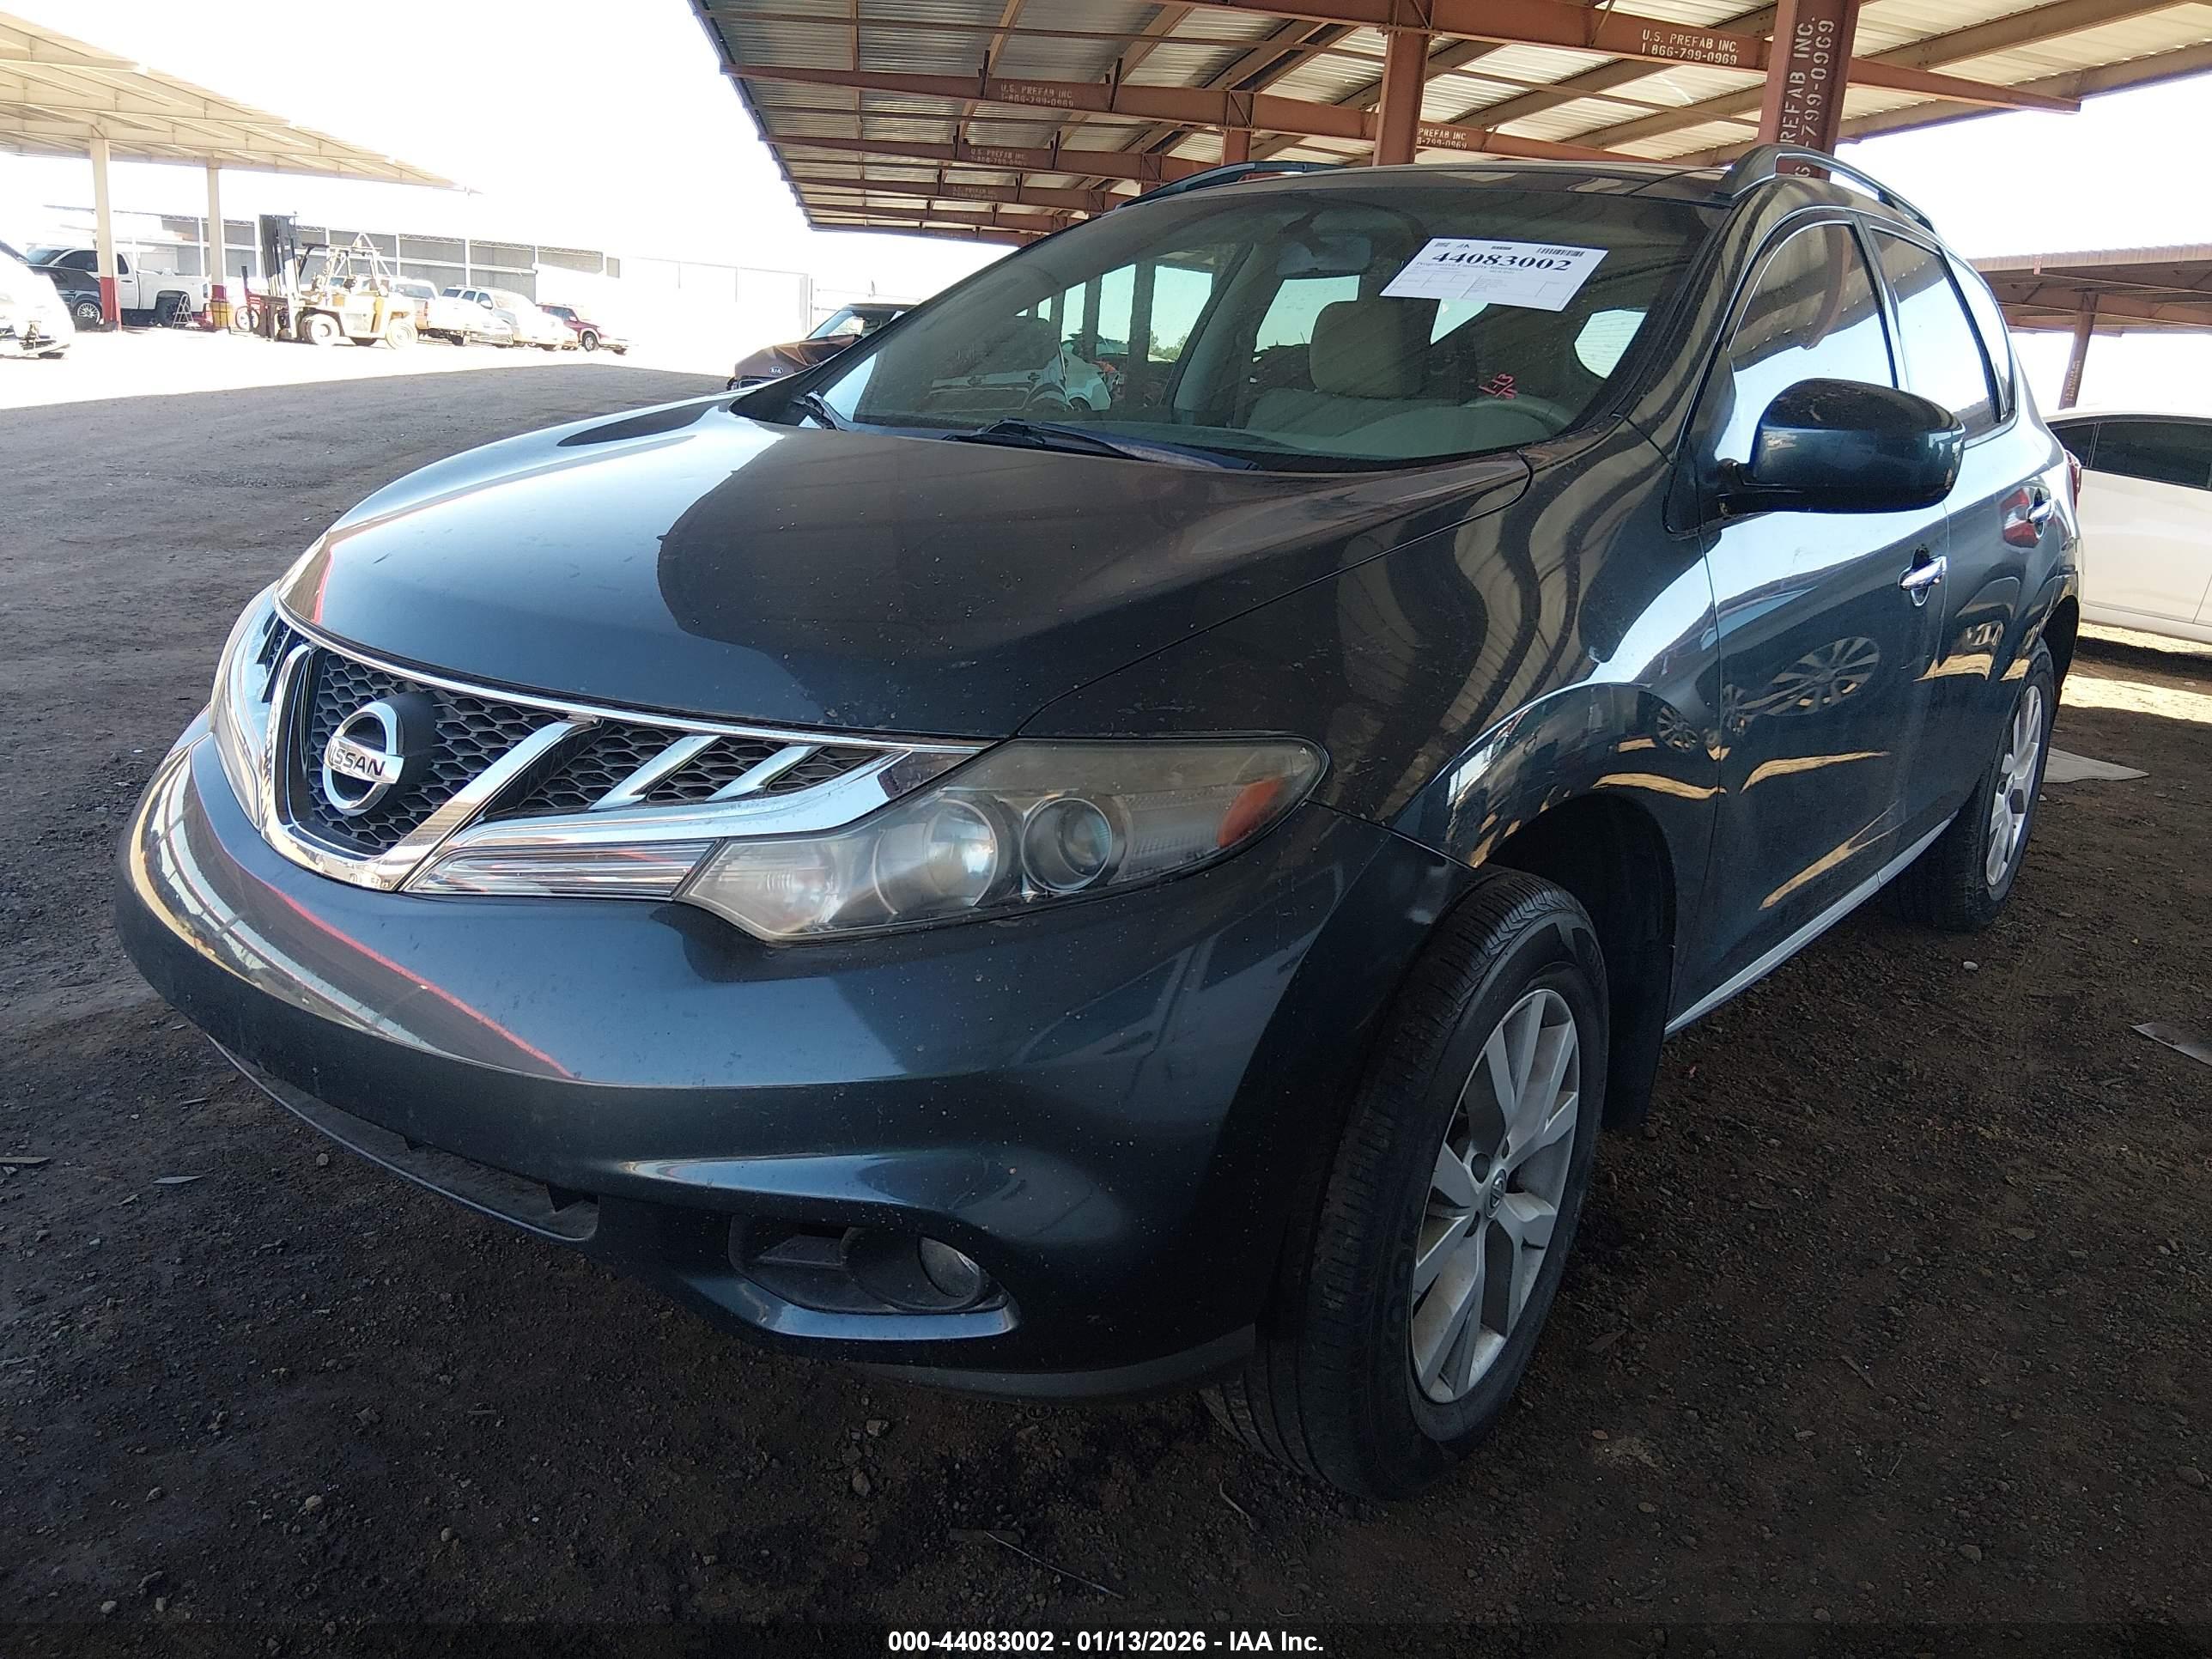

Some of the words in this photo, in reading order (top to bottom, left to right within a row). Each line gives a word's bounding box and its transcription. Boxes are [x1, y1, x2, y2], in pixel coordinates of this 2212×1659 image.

[1642, 29, 1663, 43] U.S.
[1669, 33, 1713, 49] PREFAB
[1718, 40, 1739, 52] INC.
[1779, 70, 1807, 144] REFAB
[1793, 17, 1815, 58] INC.
[1419, 128, 1449, 138] PREFAB
[1432, 252, 1572, 271] 44083002
